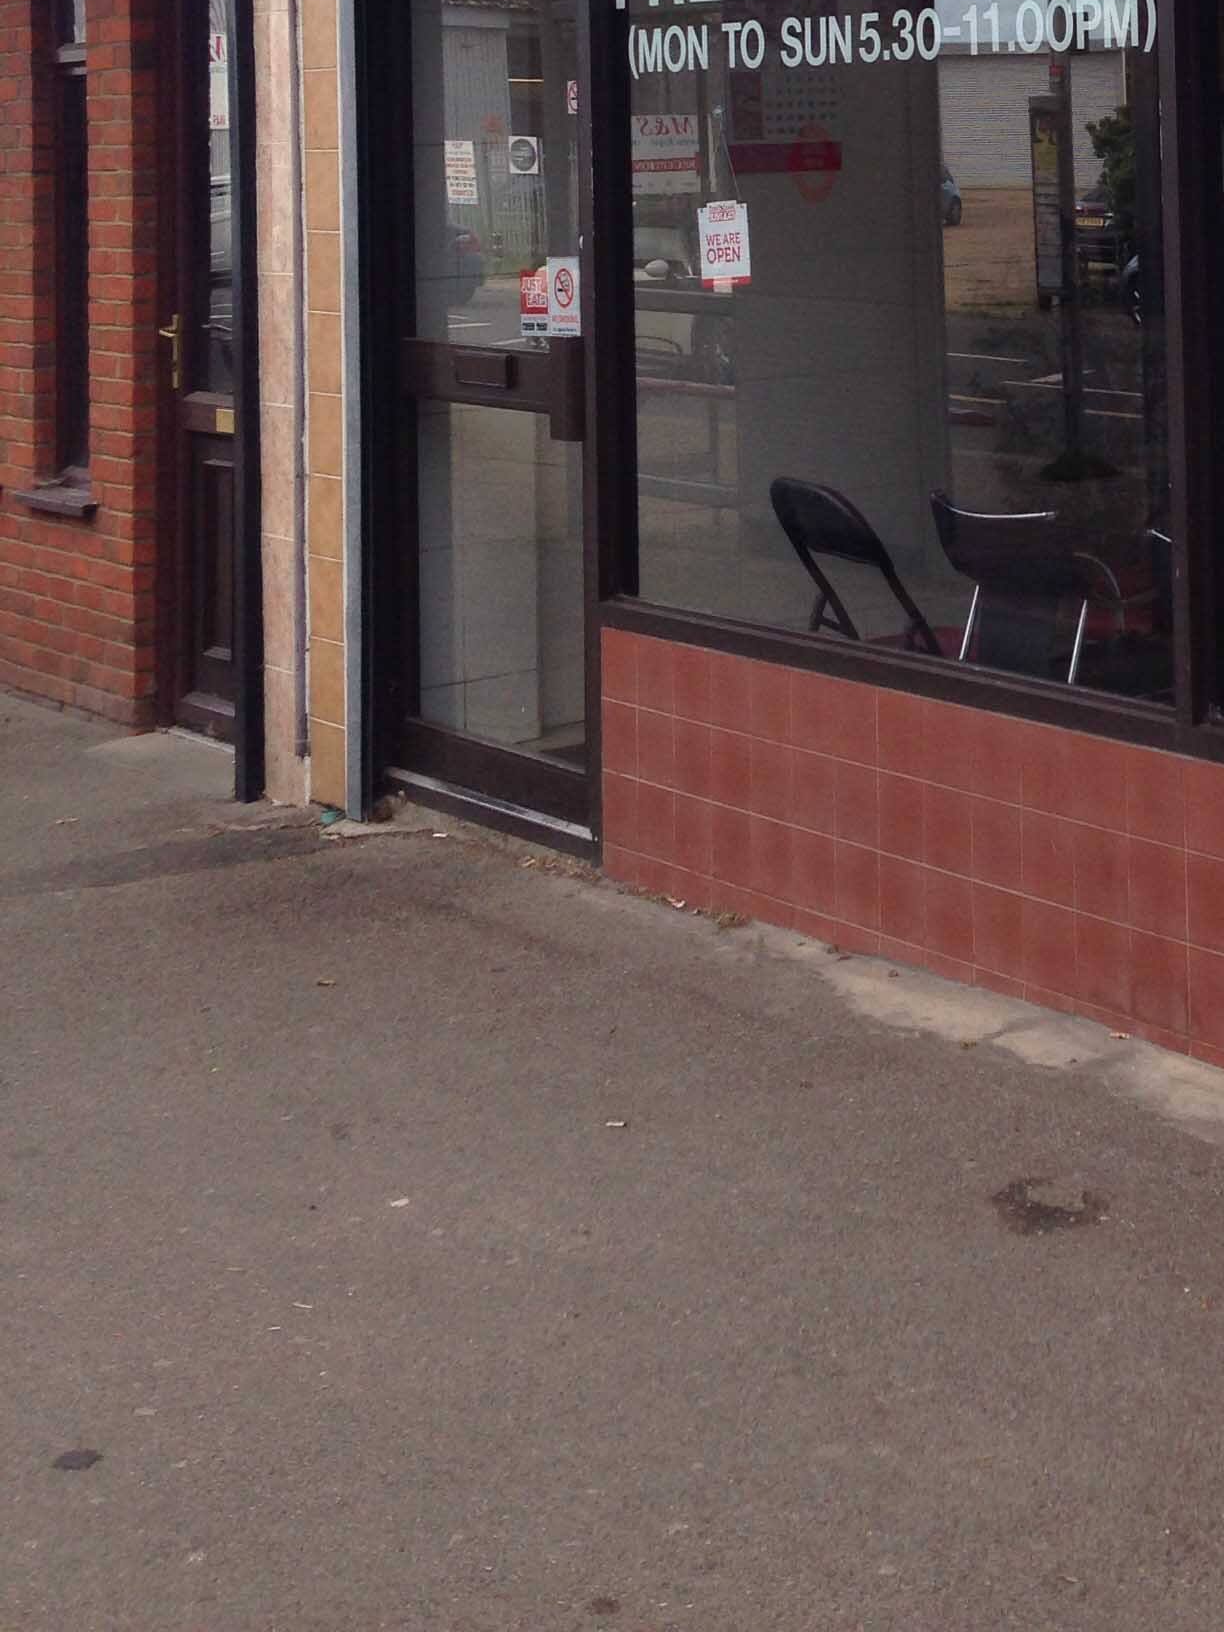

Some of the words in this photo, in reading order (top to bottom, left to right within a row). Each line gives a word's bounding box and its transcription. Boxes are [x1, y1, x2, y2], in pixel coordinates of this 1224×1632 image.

[628, 24, 710, 80] (MON
[721, 19, 766, 69] TO
[706, 233, 721, 246] WE
[723, 232, 740, 245] ARE
[706, 246, 741, 265] OPEN
